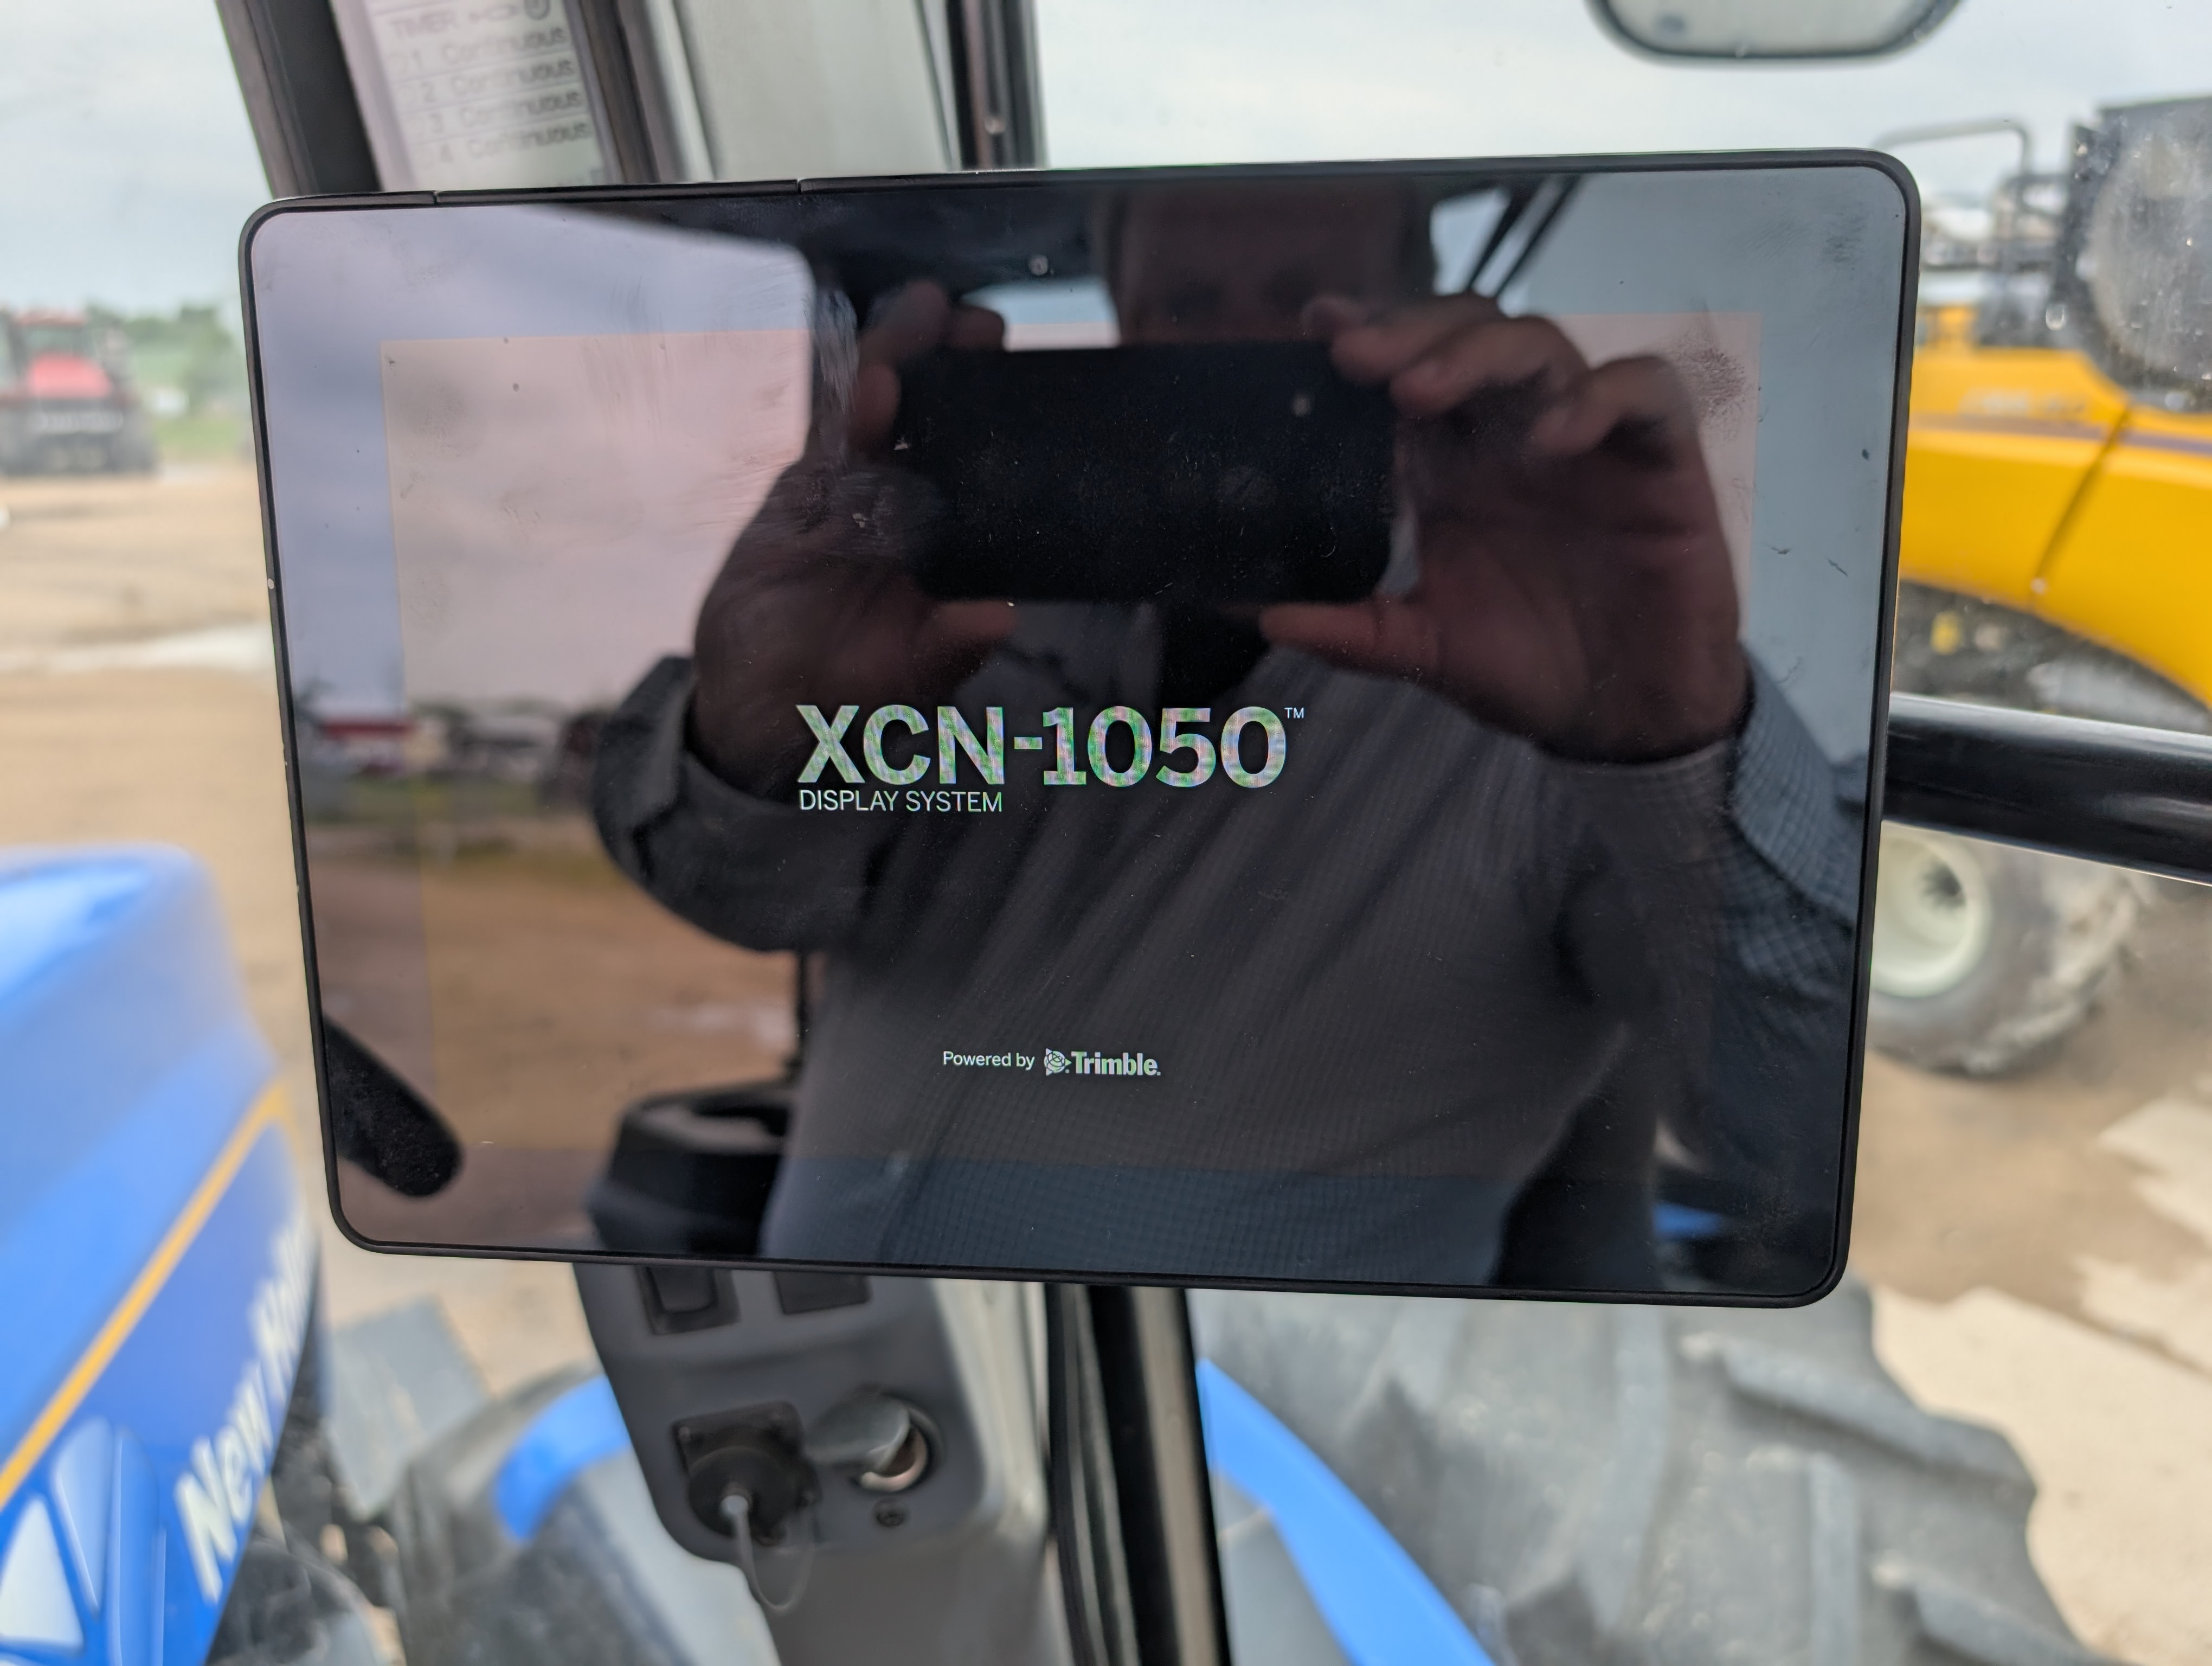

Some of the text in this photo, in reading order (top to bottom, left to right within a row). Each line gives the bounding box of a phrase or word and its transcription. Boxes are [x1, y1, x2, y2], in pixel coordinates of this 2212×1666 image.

[799, 790, 1002, 813] DISPLAY SYSTEM
[942, 1050, 1012, 1067] Powered
[1016, 1052, 1035, 1071] by
